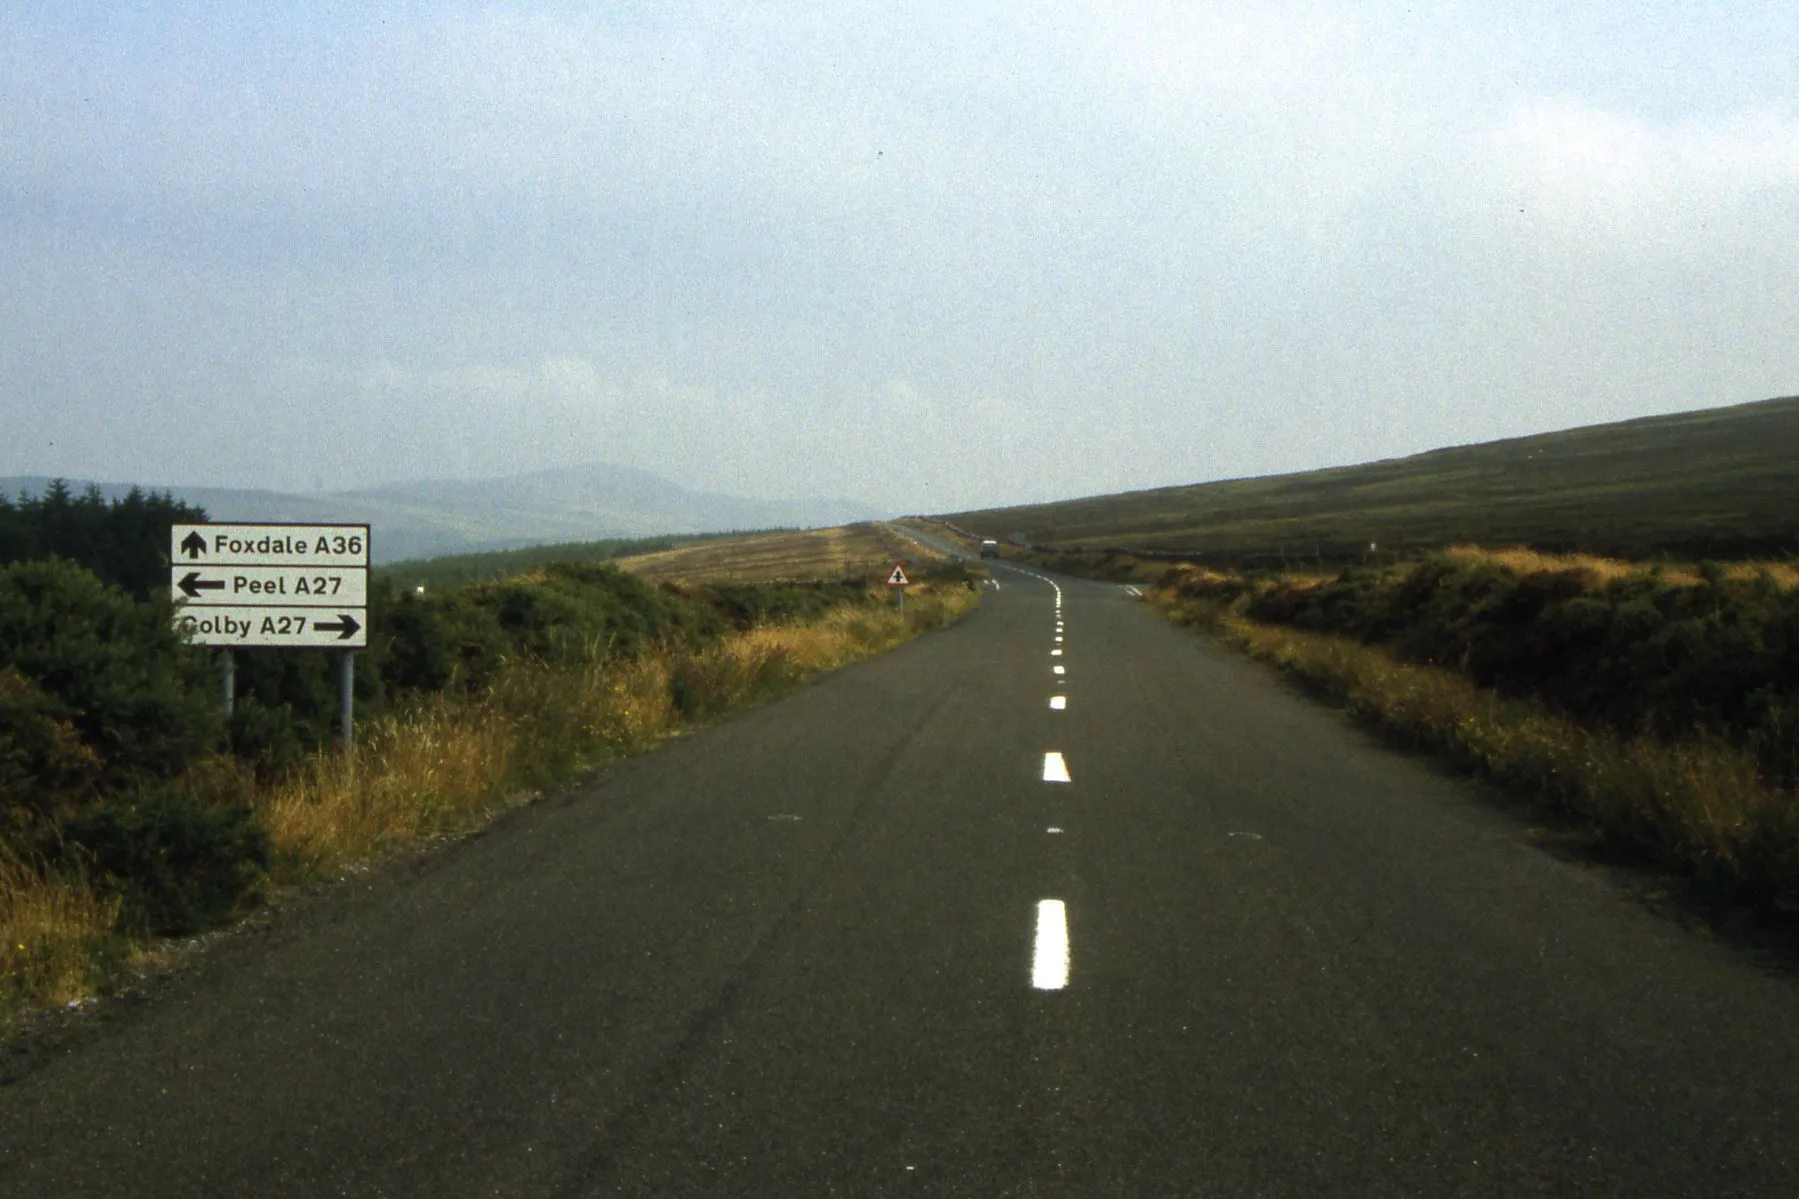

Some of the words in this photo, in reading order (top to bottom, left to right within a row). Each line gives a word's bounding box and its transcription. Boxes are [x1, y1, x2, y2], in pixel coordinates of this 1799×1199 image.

[214, 535, 308, 555] Foxdale
[314, 536, 362, 555] A36
[233, 576, 286, 594] Peel
[294, 576, 342, 595] A27
[260, 616, 307, 635] A27
